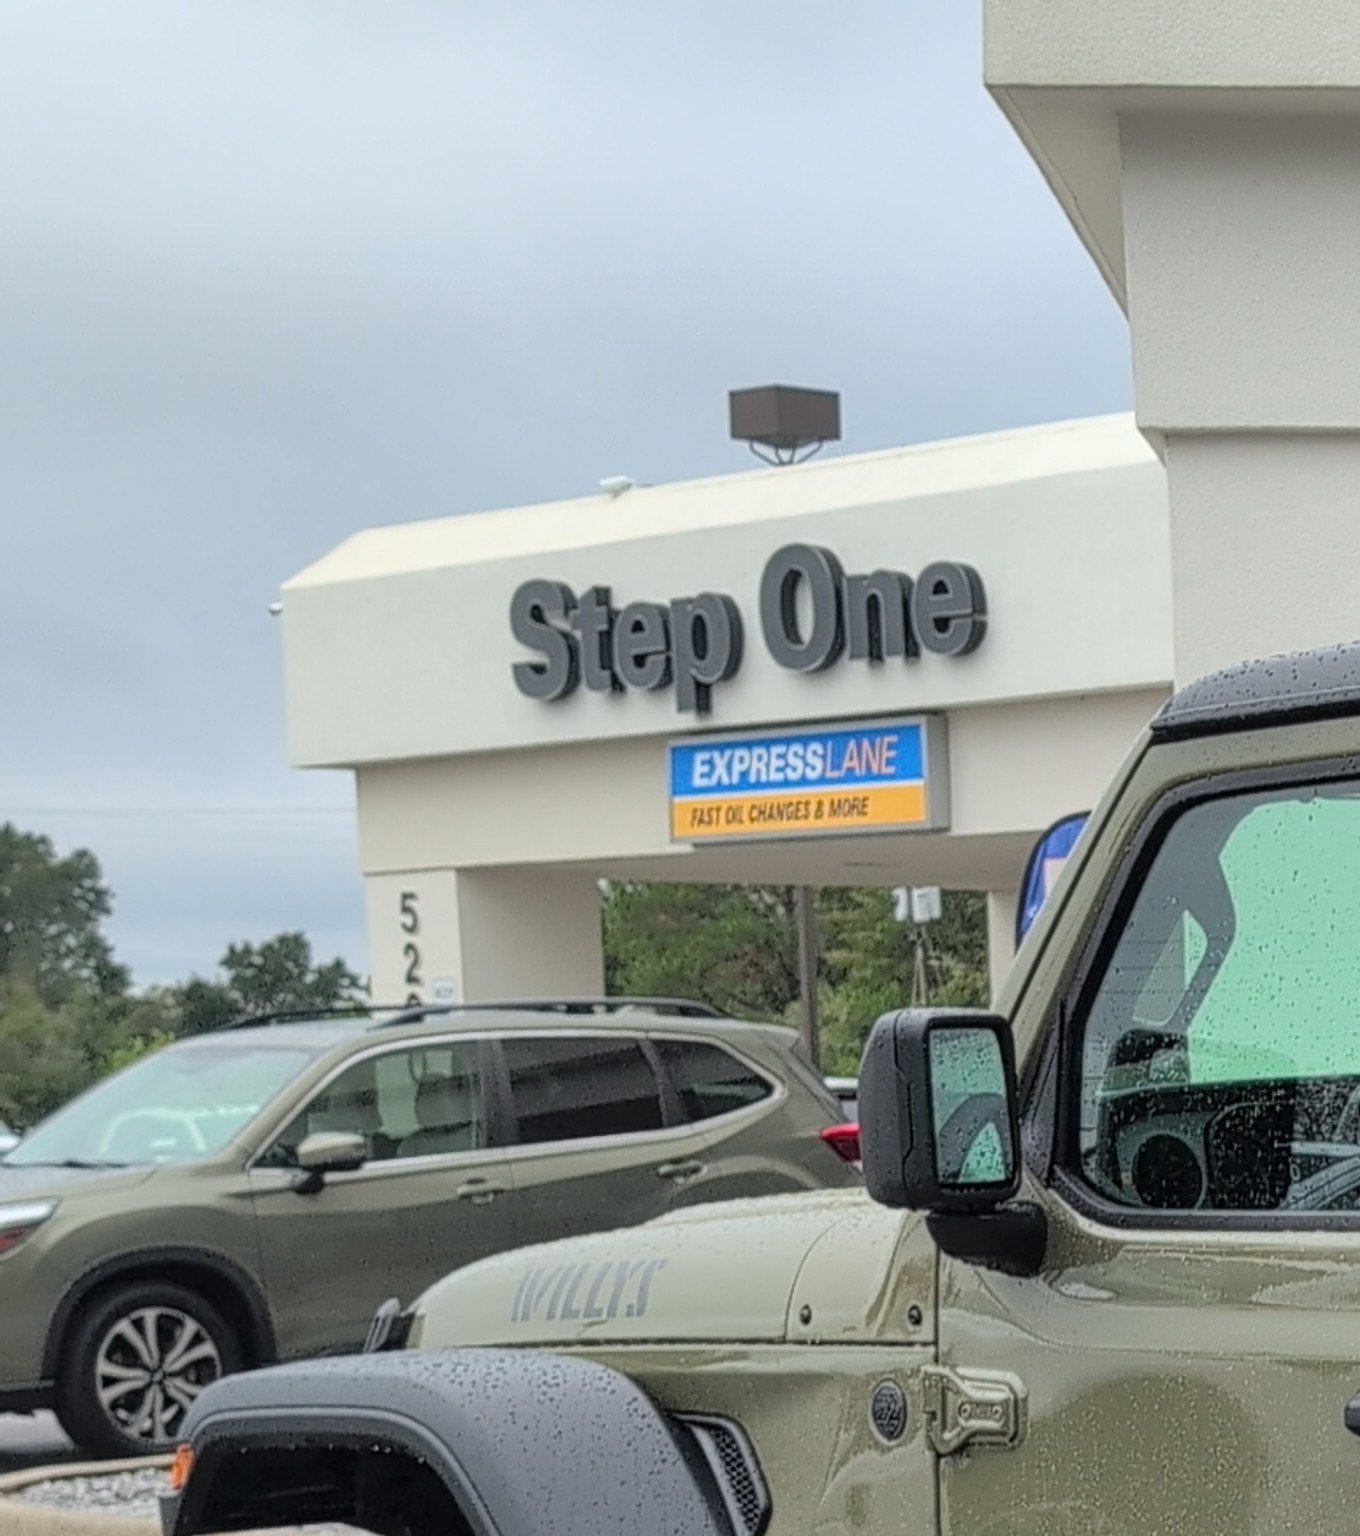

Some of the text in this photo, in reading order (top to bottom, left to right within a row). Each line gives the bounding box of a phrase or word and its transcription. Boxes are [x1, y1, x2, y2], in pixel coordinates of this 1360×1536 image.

[510, 542, 988, 717] Step One
[690, 804, 722, 828] FAST
[725, 801, 745, 825] OIL
[748, 796, 812, 823] CHANGES
[827, 795, 870, 818] MORE
[510, 1258, 668, 1323] WILLYS
